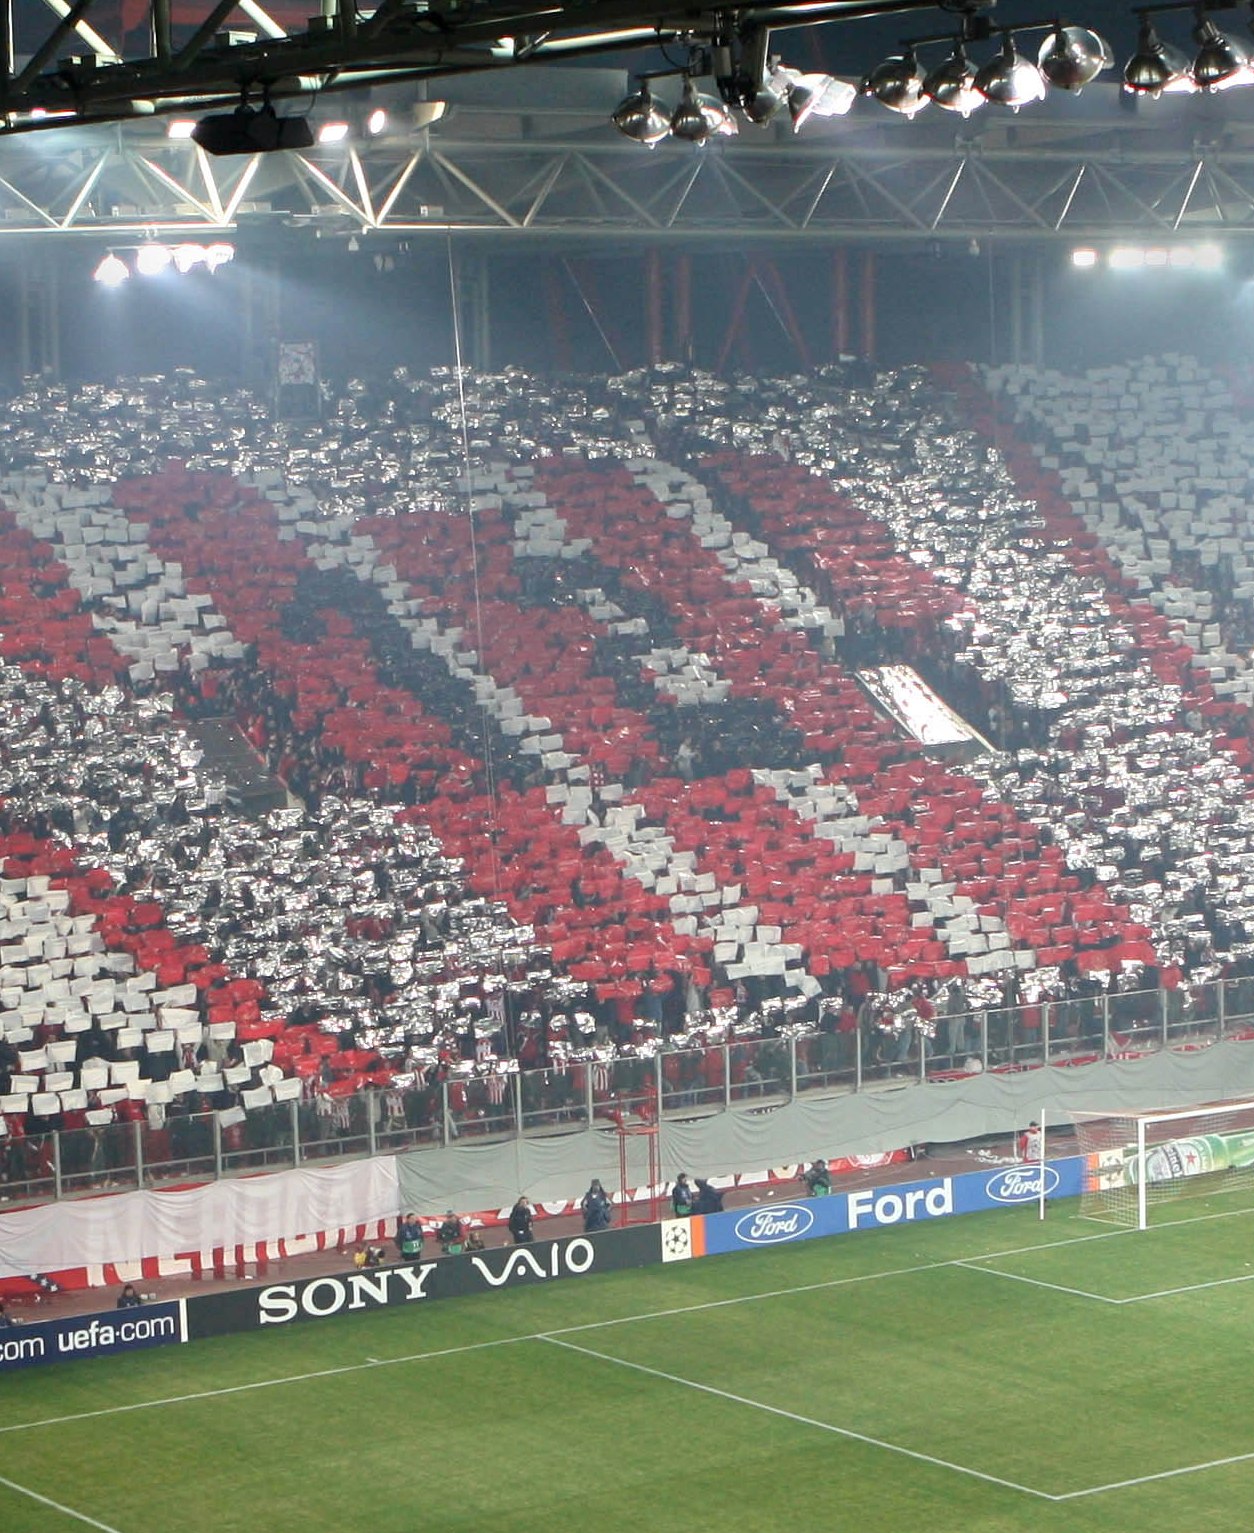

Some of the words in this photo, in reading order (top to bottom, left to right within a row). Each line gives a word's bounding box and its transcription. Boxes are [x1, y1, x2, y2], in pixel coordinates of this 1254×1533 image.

[750, 1209, 798, 1237] Ford
[848, 1177, 953, 1229] Ford
[1000, 1171, 1043, 1197] Ford
[472, 1237, 595, 1286] VAIO
[258, 1263, 437, 1324] SONY
[0, 1336, 45, 1363] om
